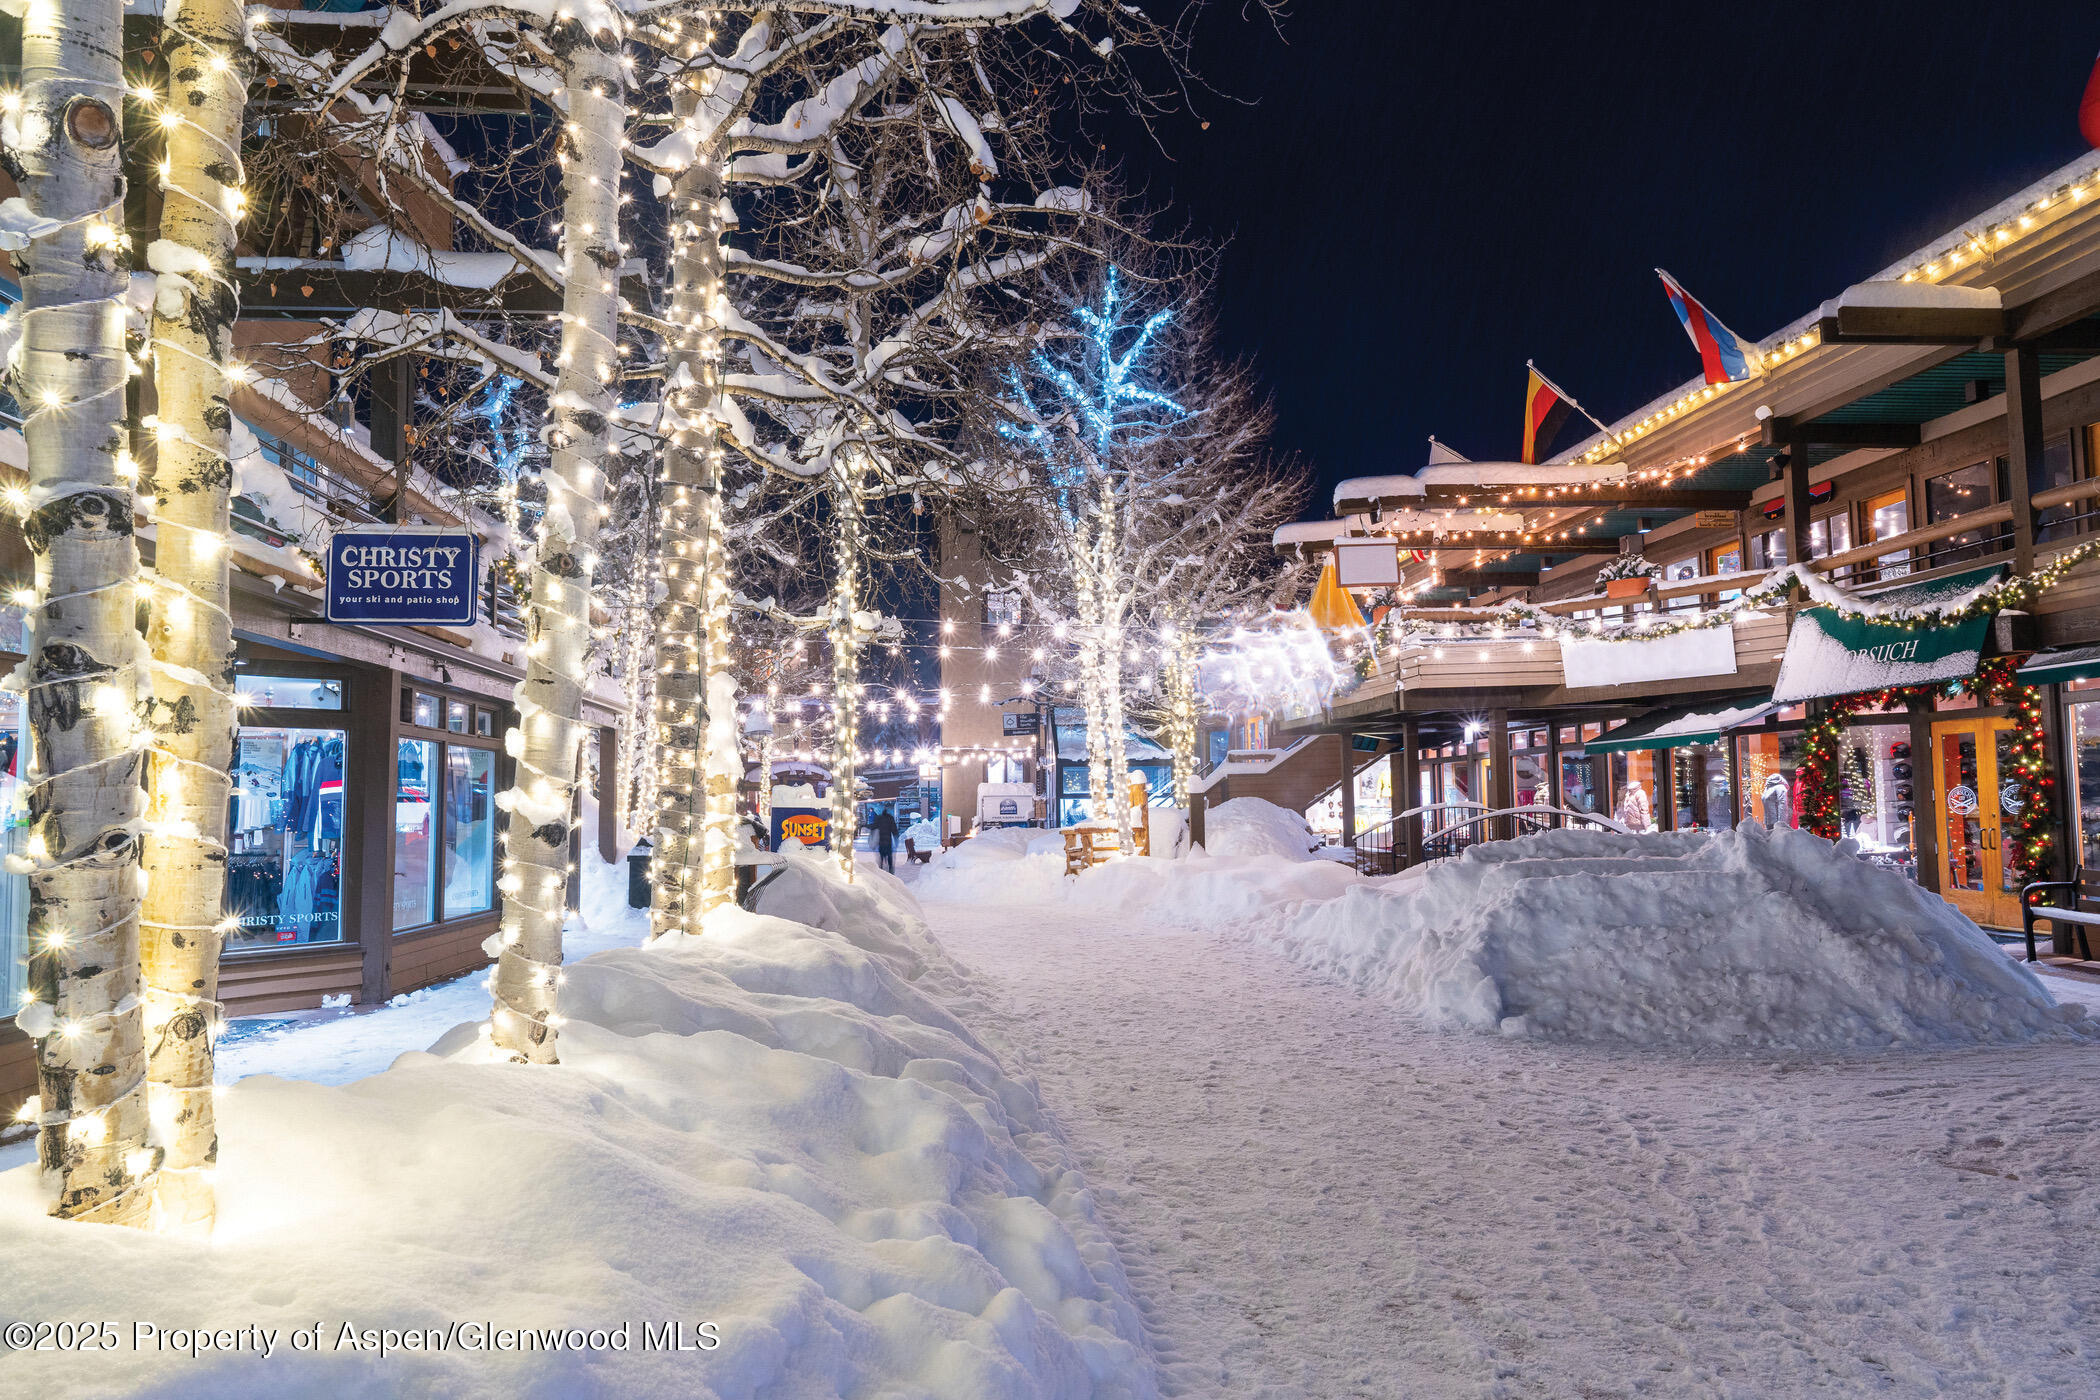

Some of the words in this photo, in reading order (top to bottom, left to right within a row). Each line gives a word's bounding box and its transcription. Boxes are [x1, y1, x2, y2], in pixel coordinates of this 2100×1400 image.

[340, 546, 462, 568] CHRISTY
[347, 570, 452, 589] SPORTS
[339, 596, 362, 605] your
[365, 595, 381, 603] ski
[384, 595, 403, 603] and
[406, 596, 433, 605] patio
[436, 595, 460, 605] shop
[781, 819, 828, 841] SUNSET
[238, 914, 286, 927] RISTY
[288, 911, 338, 924] SPORTS
